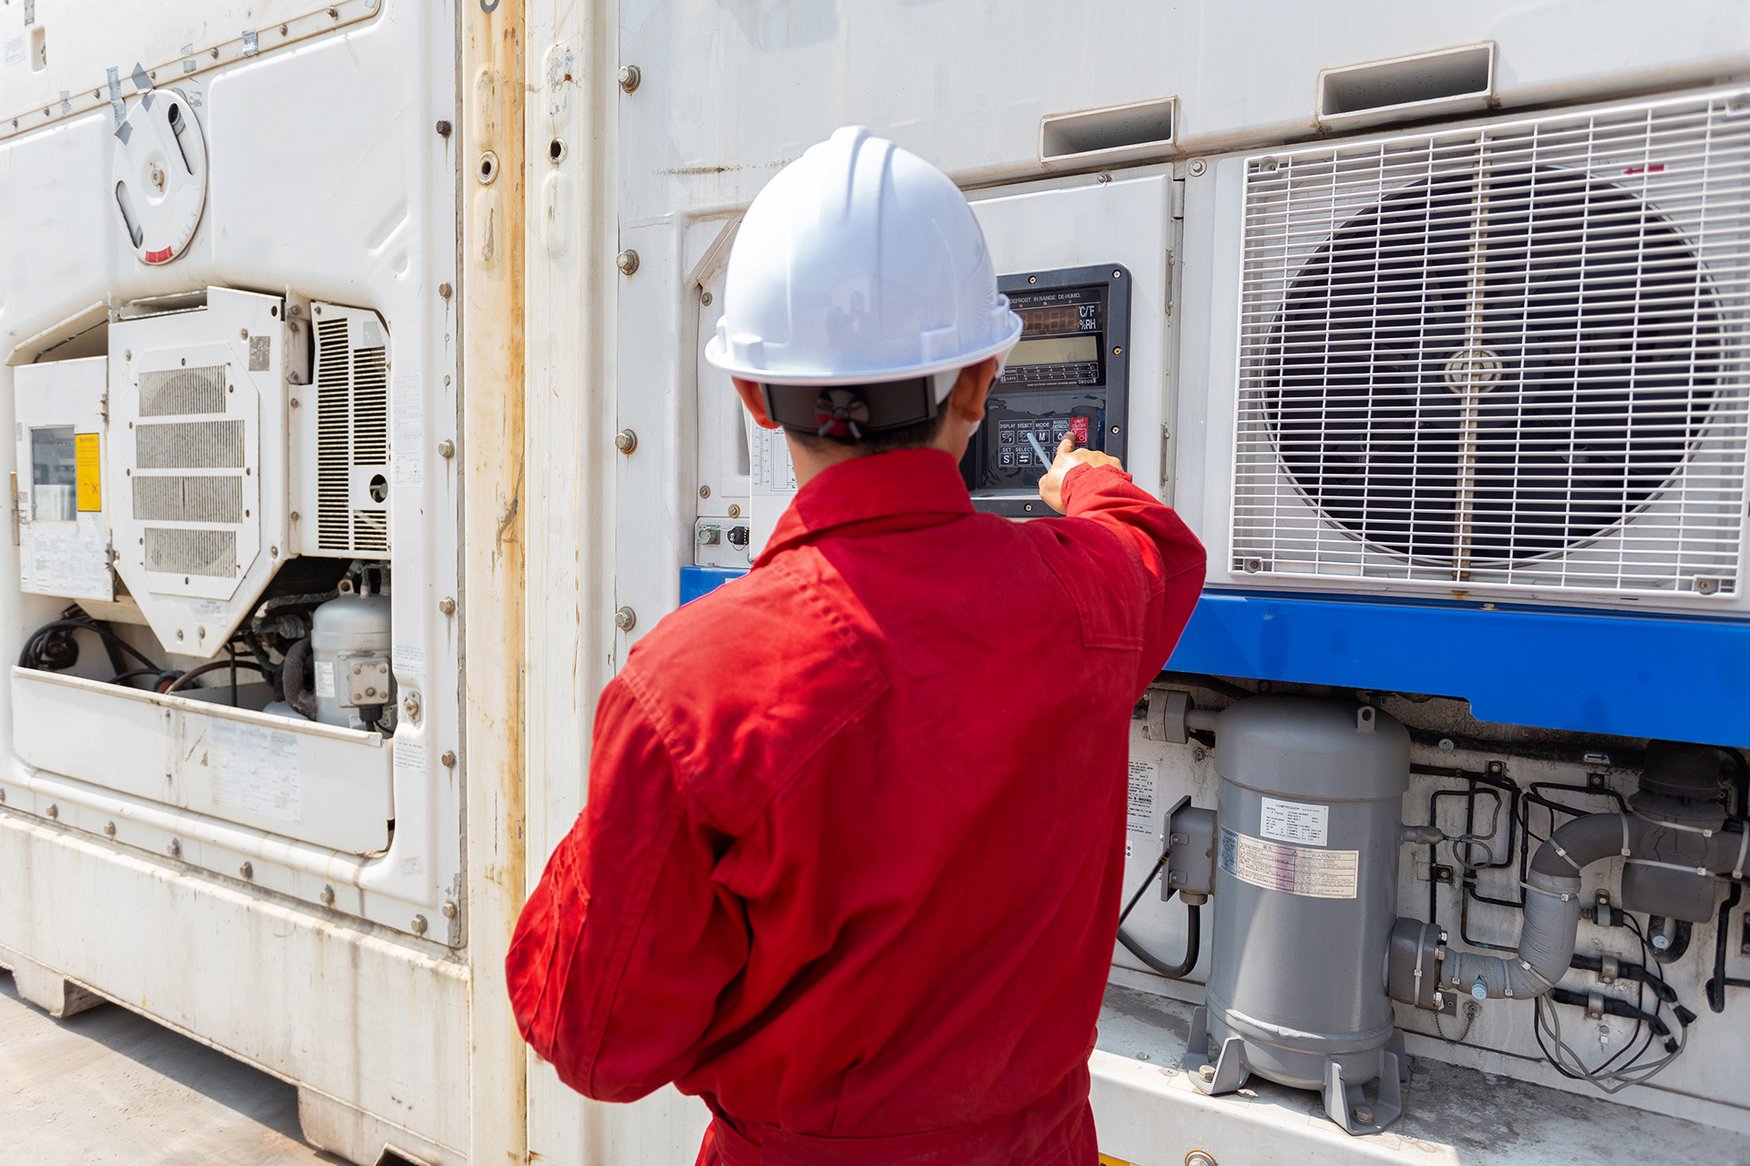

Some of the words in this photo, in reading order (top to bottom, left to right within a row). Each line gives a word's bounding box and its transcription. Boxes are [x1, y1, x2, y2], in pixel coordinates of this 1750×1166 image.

[1079, 319, 1096, 330] %RH
[1038, 433, 1046, 441] M
[1003, 455, 1010, 464] S
